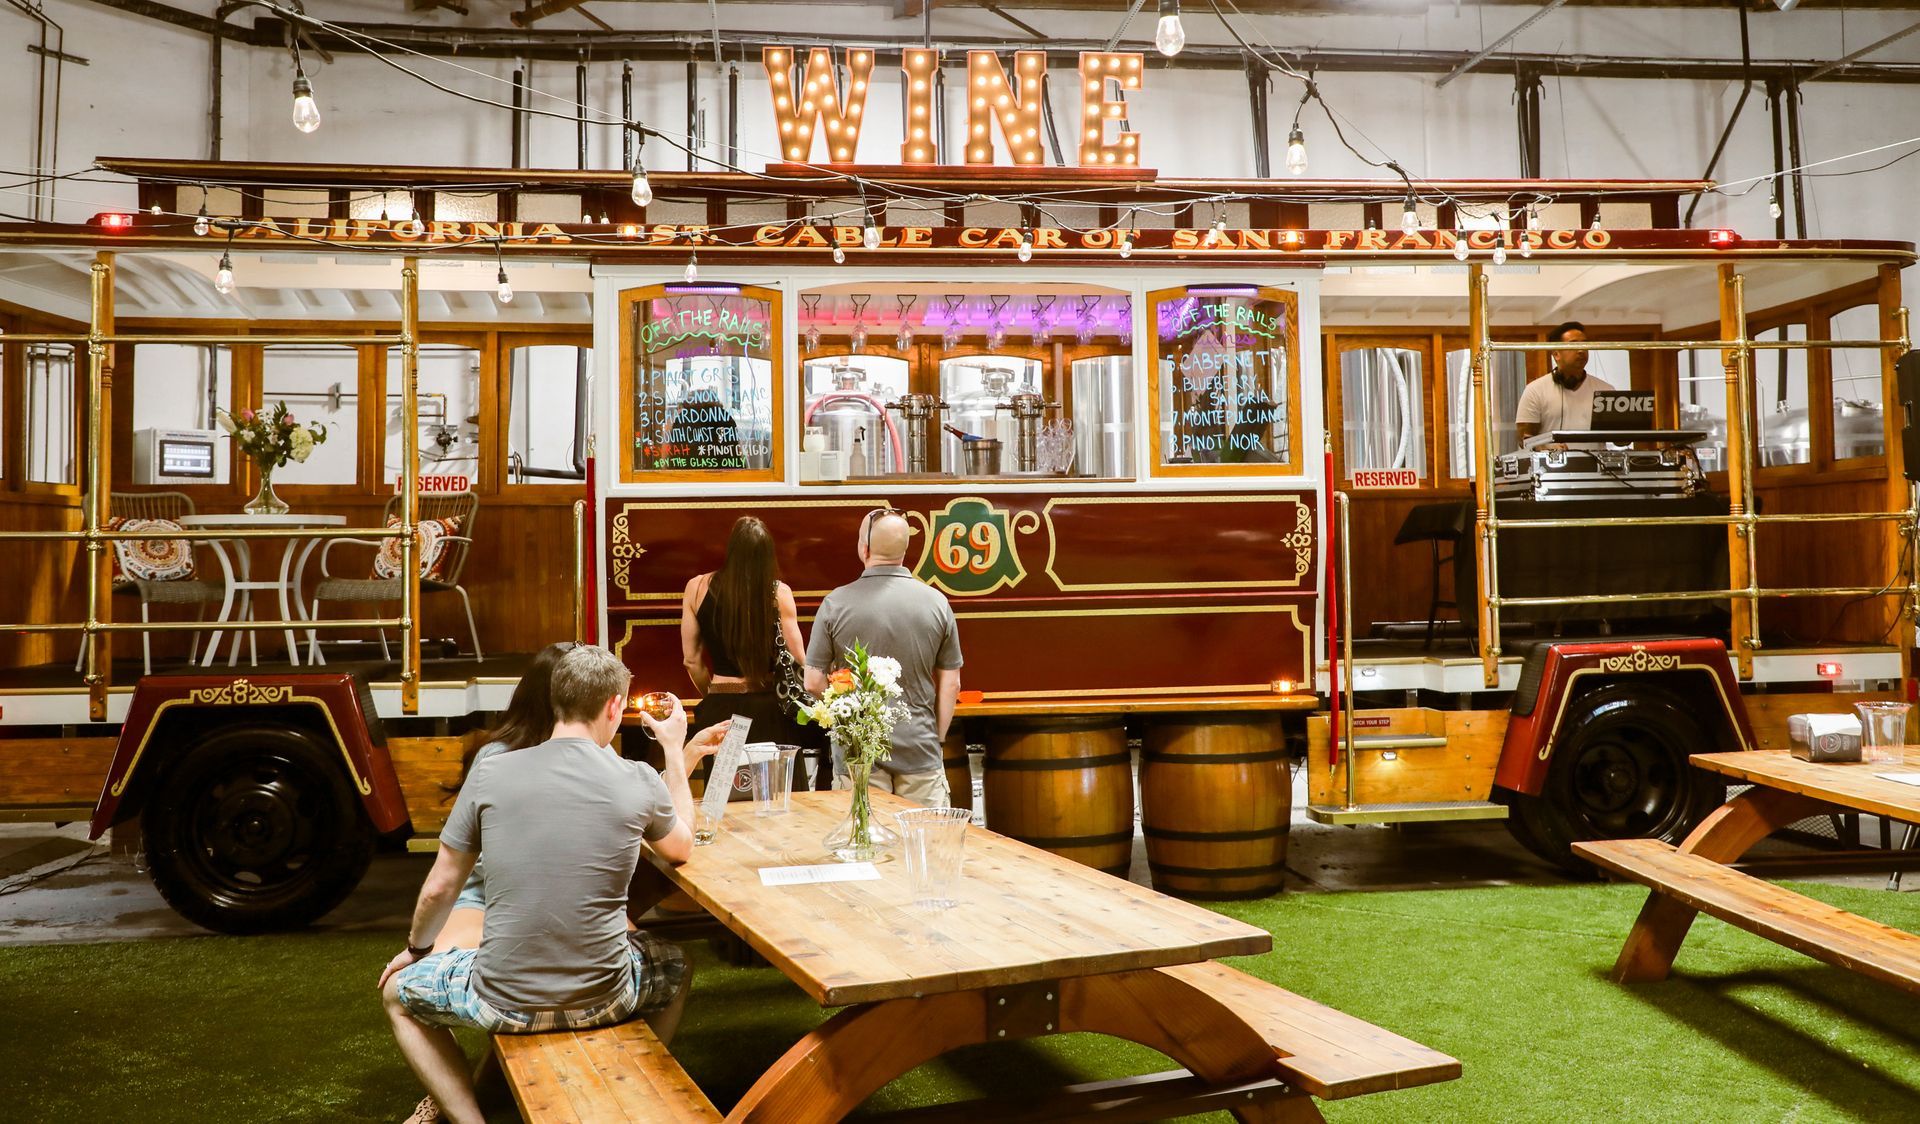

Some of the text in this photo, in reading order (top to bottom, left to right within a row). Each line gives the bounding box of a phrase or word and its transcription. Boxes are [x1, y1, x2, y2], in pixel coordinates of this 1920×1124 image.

[762, 46, 1144, 167] WINE
[207, 216, 572, 243] CALIFORNIA
[752, 225, 932, 248] CABLE
[958, 228, 1068, 249] CAR
[1081, 228, 1142, 249] OF
[1171, 229, 1271, 249] SAN
[1323, 229, 1612, 250] FRANCISCO
[641, 309, 763, 344] OFF THE RAILS
[1171, 304, 1277, 332] OFF THE RAILS
[1181, 351, 1269, 373] CABERNET
[640, 368, 649, 384] 1.
[1183, 374, 1256, 392] BLUEBERRY
[639, 391, 651, 407] 2.
[1209, 389, 1270, 407] SANGRIA
[1593, 396, 1654, 413] STOKE
[655, 405, 742, 425] CHARDONNA
[656, 428, 684, 445] SOUTH
[1182, 433, 1225, 452] PINOT
[1230, 433, 1264, 451] NOIR
[707, 444, 733, 457] PINOT
[671, 457, 687, 468] THE
[690, 457, 718, 468] GLASS
[721, 457, 747, 468] ONLY
[397, 476, 468, 492] RSERVED
[1355, 471, 1417, 486] RESERVED
[933, 522, 1001, 575] 69
